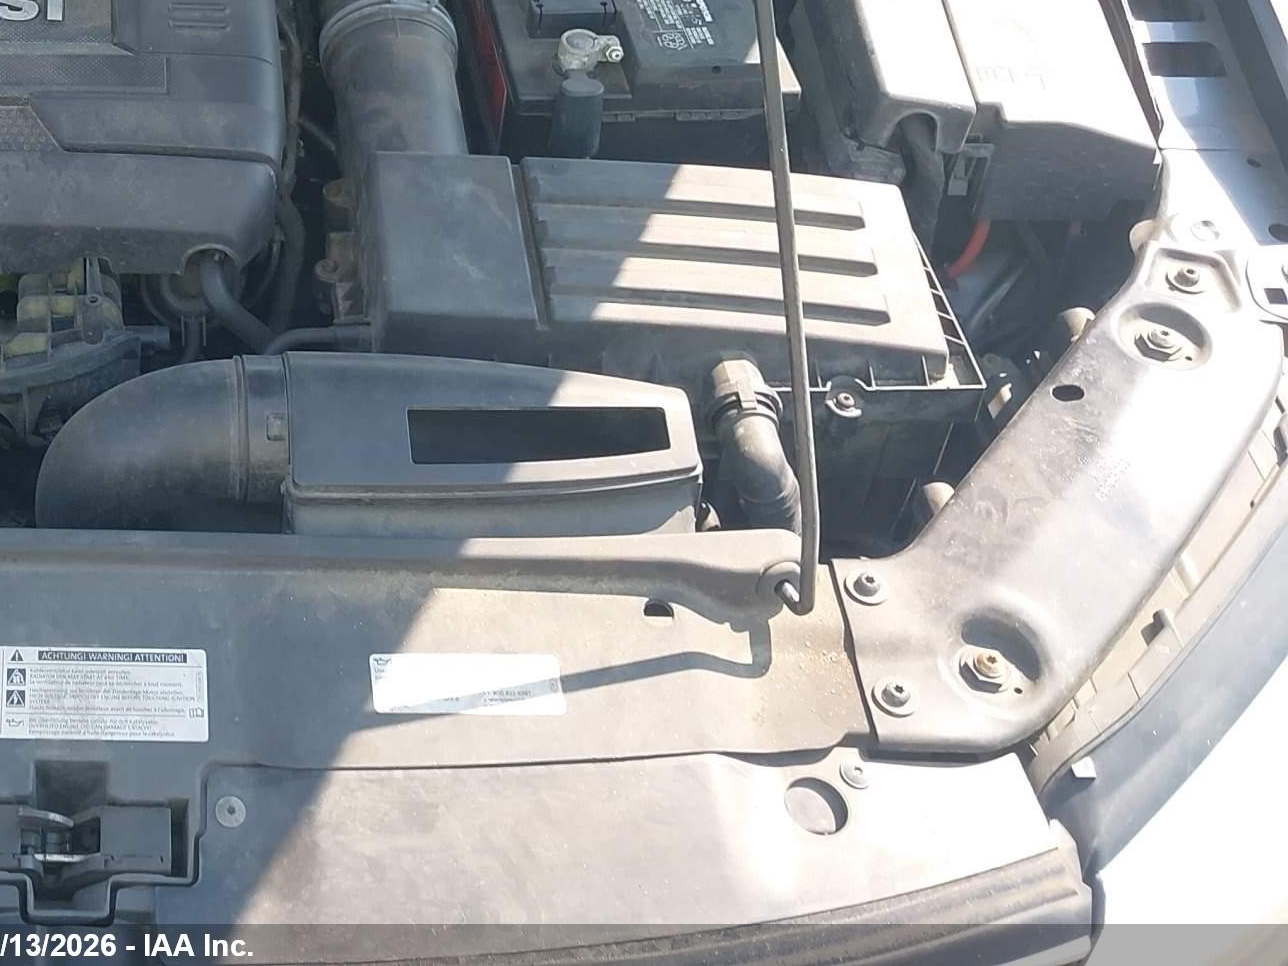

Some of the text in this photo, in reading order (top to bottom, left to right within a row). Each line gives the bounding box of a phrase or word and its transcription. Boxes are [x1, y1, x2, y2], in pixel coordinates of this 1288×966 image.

[41, 650, 184, 663] ACHTUNG! WARNING! ATTENTION!
